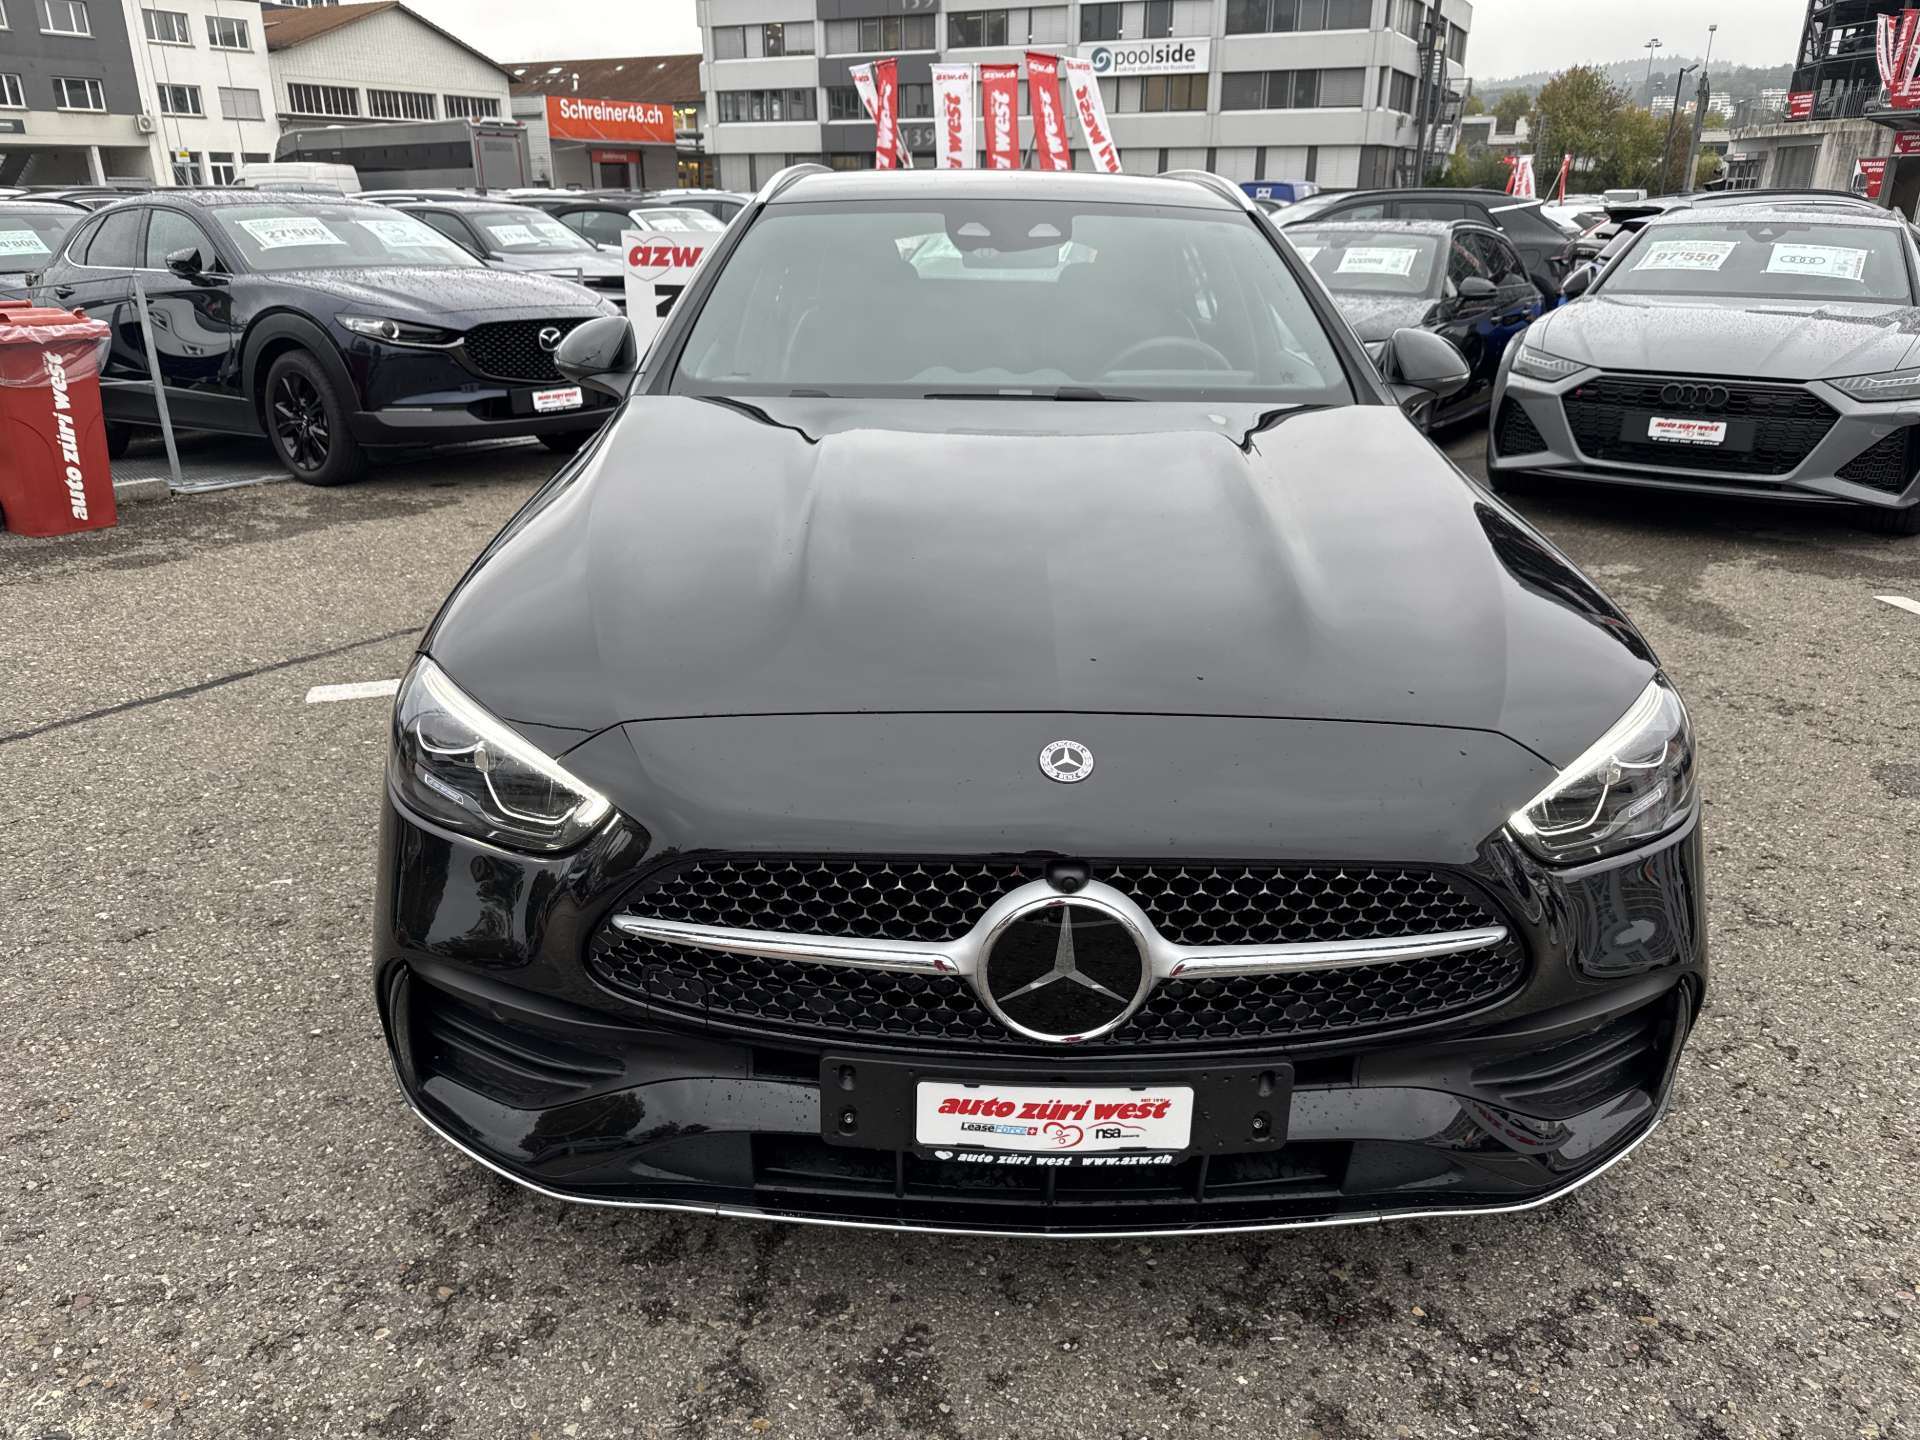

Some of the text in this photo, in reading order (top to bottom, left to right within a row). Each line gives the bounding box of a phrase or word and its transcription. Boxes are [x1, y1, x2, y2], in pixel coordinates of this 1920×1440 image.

[1114, 43, 1196, 72] poolside
[936, 73, 969, 81] azw.ch
[560, 98, 663, 124] Schreiner48.ch
[944, 91, 962, 152] west
[992, 90, 1011, 152] west
[1039, 85, 1064, 153] west
[629, 246, 704, 267] azw
[1656, 251, 1720, 262] 97'550
[42, 351, 88, 521] auto züri west
[938, 1097, 1171, 1120] auto züri west
[961, 1122, 1027, 1136] LeaseForce
[1096, 1128, 1121, 1139] nsa
[958, 1153, 1173, 1166] auto züri west www.azw.ch
